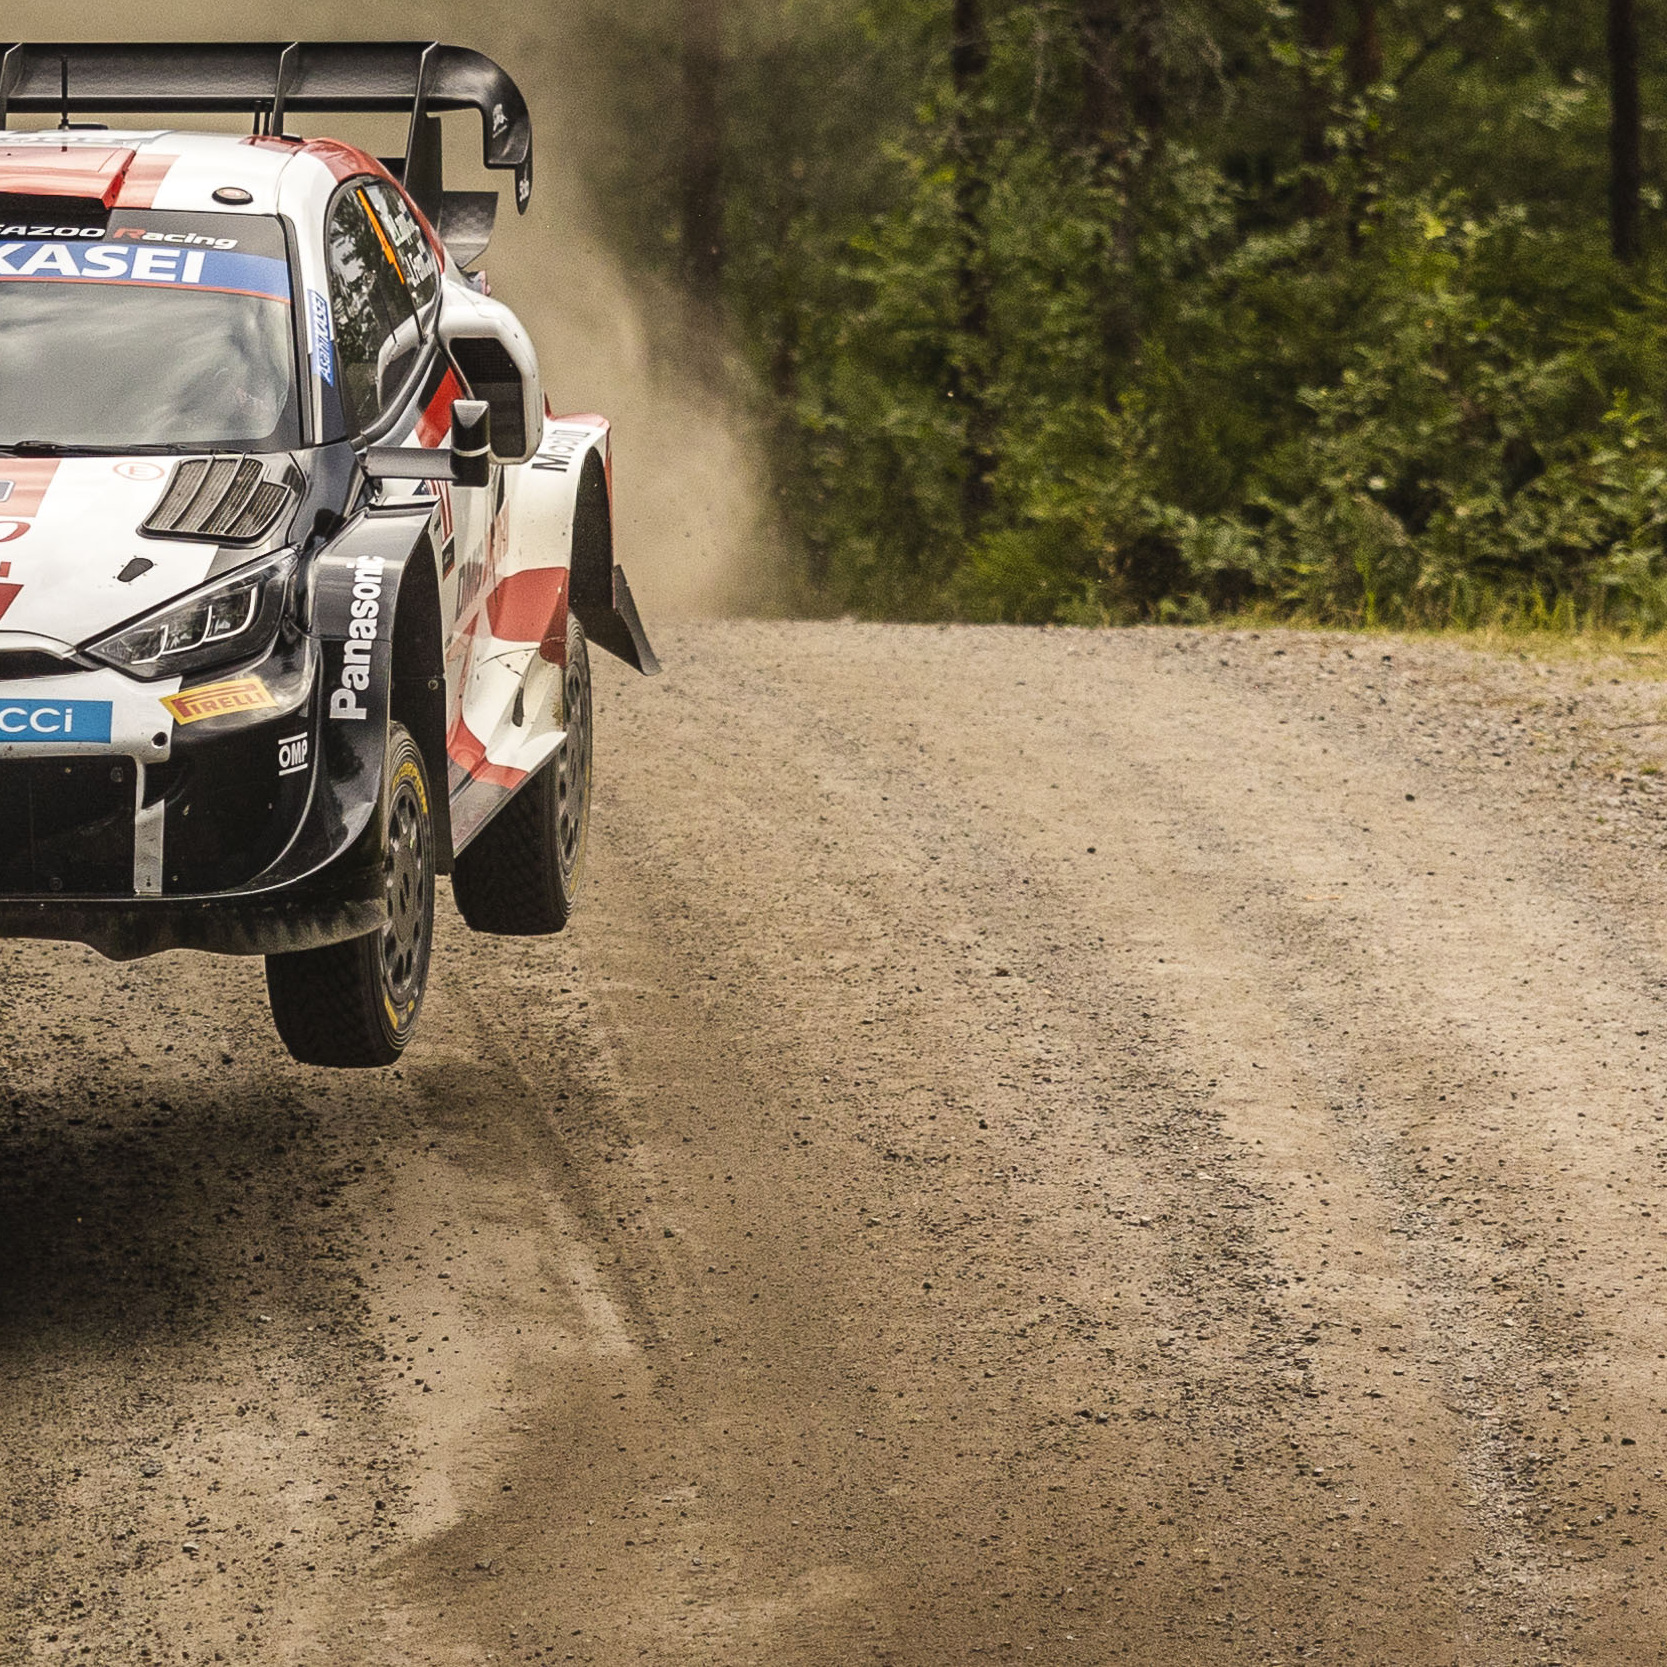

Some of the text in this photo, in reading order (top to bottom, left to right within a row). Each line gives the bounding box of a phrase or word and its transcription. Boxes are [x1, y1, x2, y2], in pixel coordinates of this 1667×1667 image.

[113, 227, 238, 250] Racing
[329, 555, 386, 720] Panasonic
[171, 683, 267, 718] PIRELLI
[278, 738, 308, 769] OMP
